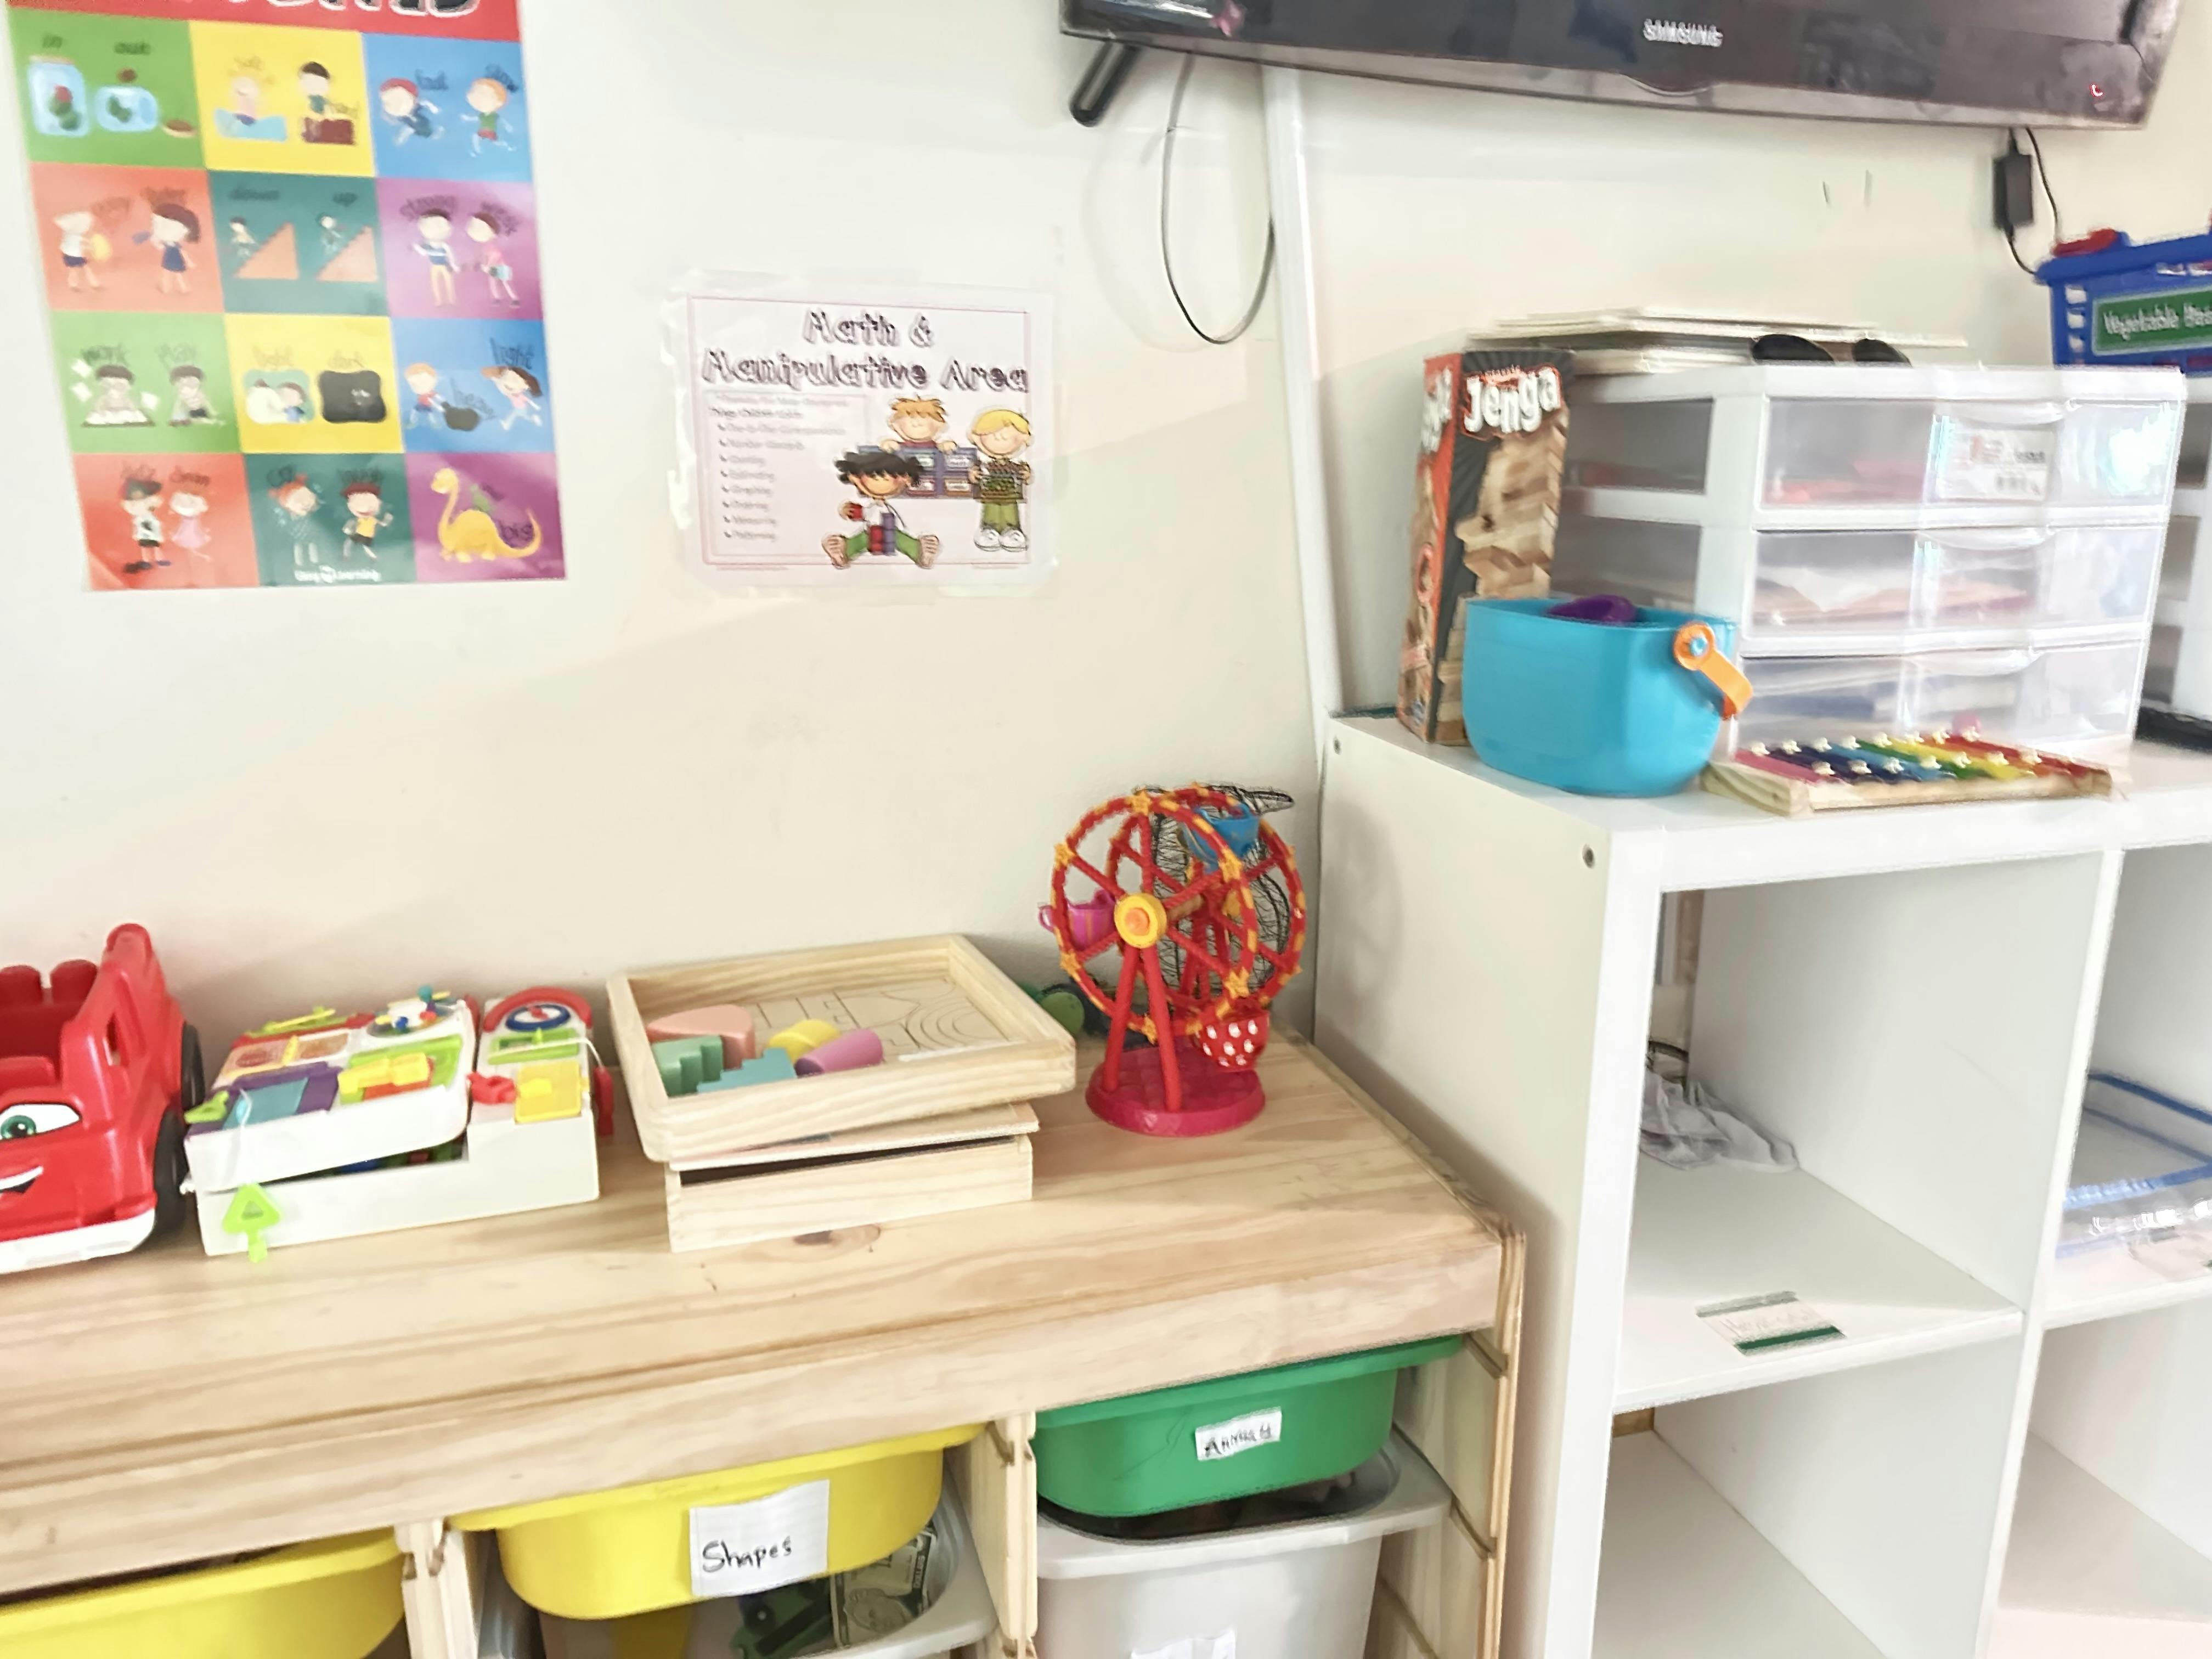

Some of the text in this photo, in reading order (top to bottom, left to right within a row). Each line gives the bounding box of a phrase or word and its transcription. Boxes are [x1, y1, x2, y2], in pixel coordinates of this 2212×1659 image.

[1643, 18, 1724, 47] SAMSUNG
[803, 308, 935, 348] Math &
[702, 347, 1029, 394] Manipulative Area
[1464, 366, 1561, 433] Jenga
[703, 1536, 792, 1573] Shapes
